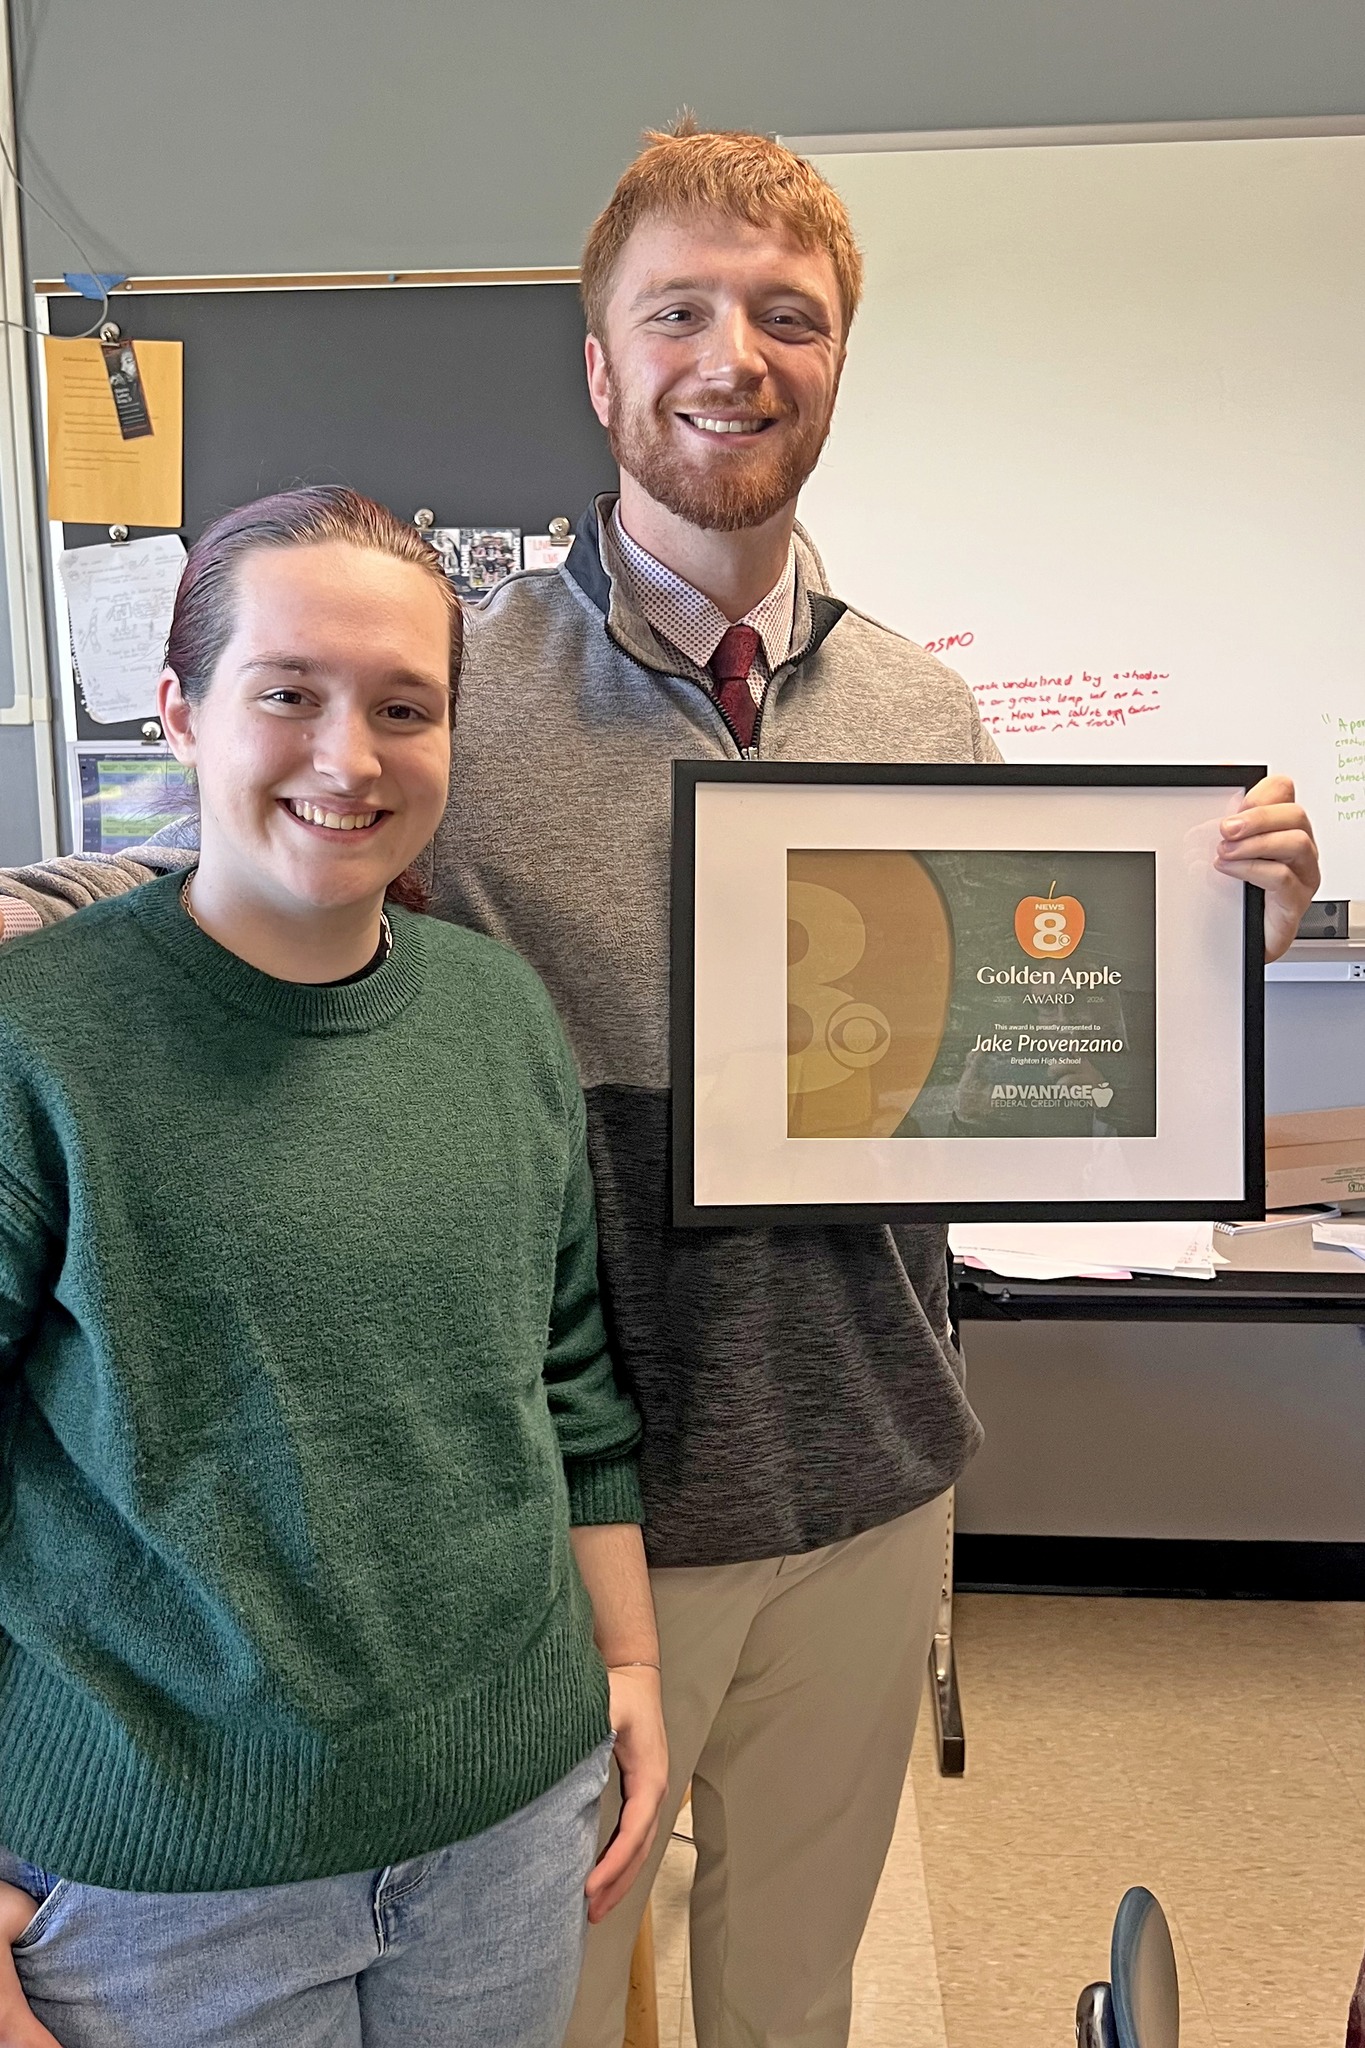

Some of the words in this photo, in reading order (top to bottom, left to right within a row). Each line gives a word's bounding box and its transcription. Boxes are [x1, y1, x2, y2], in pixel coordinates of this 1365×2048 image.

[460, 544, 471, 577] HOME
[512, 537, 521, 573] OMING
[1082, 671, 1101, 687] by
[1033, 912, 1067, 952] 8
[976, 966, 1056, 985] Golden
[1060, 966, 1122, 990] Apple
[1022, 993, 1075, 1005] AWARD
[994, 1023, 1008, 1031] This
[1009, 1023, 1028, 1031] award
[1029, 1023, 1035, 1031] is
[1036, 1023, 1060, 1032] proudly
[1061, 1023, 1092, 1032] presented
[971, 1034, 1013, 1052] Jake
[1018, 1034, 1124, 1053] Provenzano
[1010, 1057, 1040, 1066] Brighton
[1041, 1057, 1058, 1066] High
[1058, 1056, 1082, 1066] School
[991, 1084, 1093, 1100] ADVANTAGE
[991, 1100, 1028, 1108] FEDERAL
[1030, 1100, 1061, 1108] CREDIT
[1064, 1100, 1093, 1108] UNION
